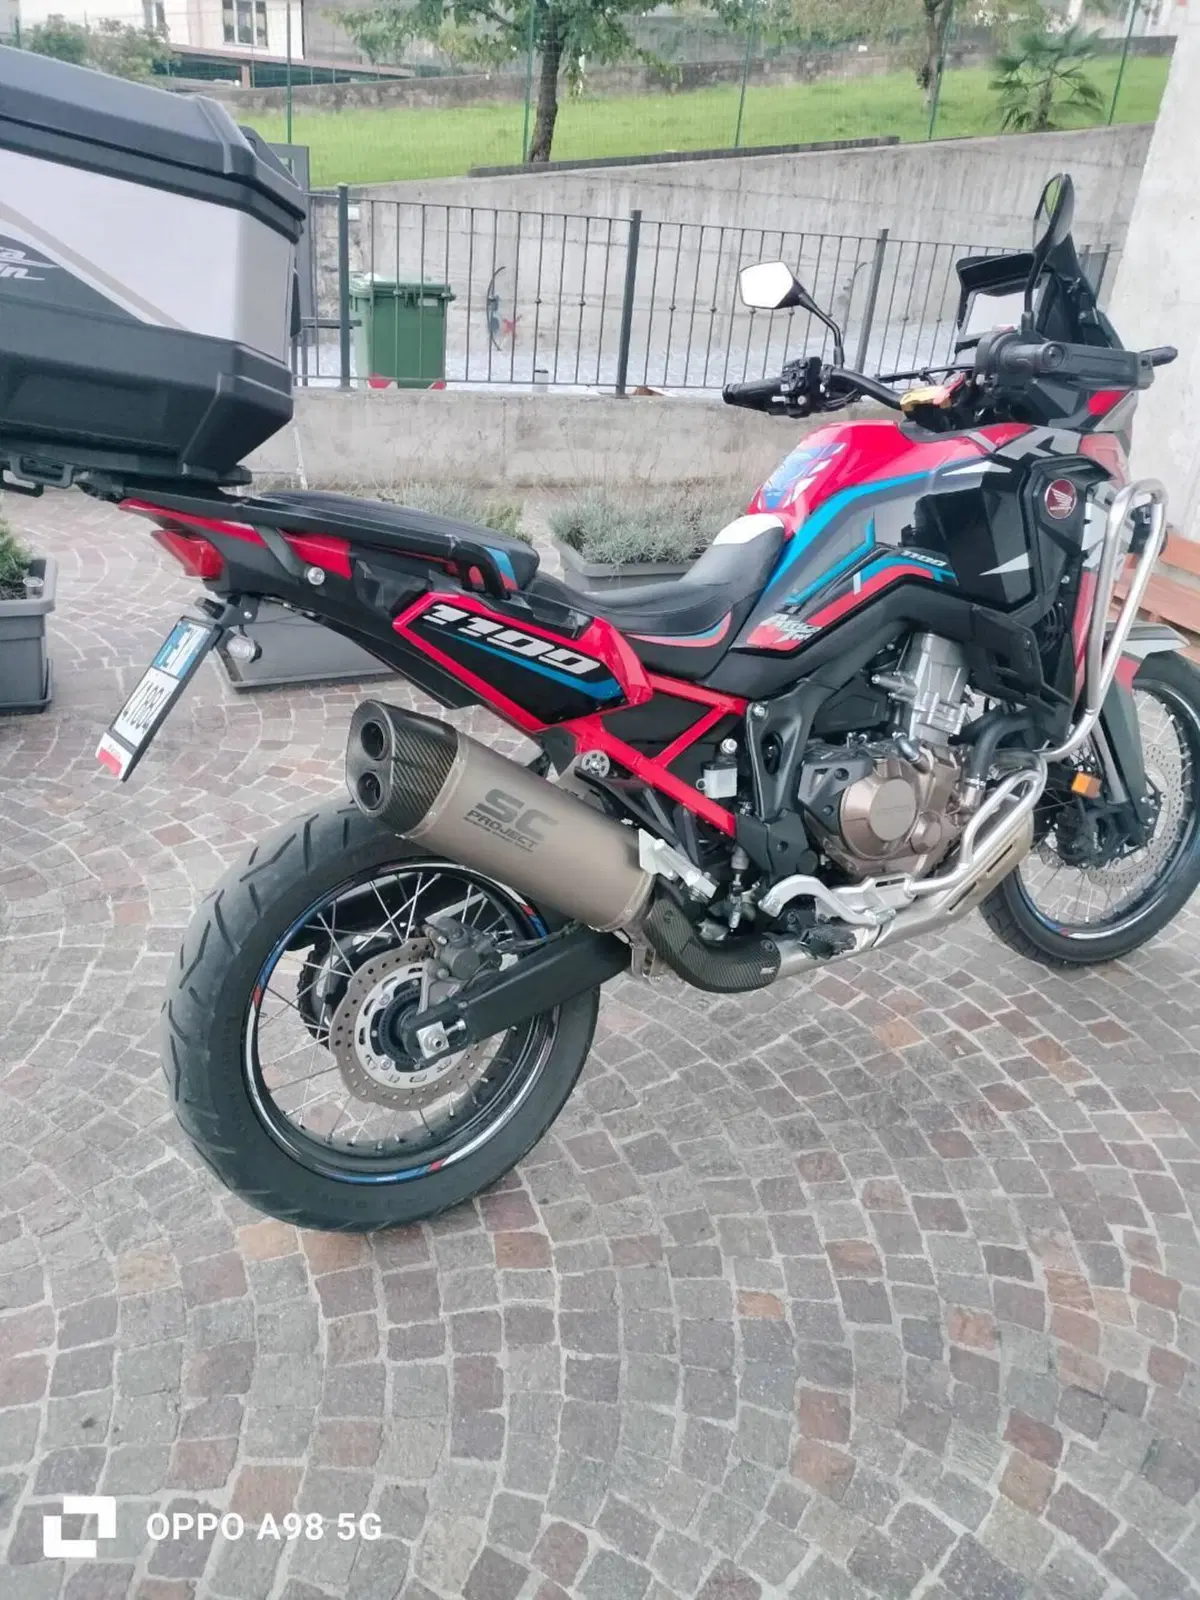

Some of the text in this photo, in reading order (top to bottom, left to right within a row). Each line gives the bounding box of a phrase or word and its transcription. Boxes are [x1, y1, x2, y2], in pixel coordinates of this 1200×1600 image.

[422, 604, 601, 675] 1100
[466, 809, 540, 849] PROJECT
[475, 788, 559, 842] SC
